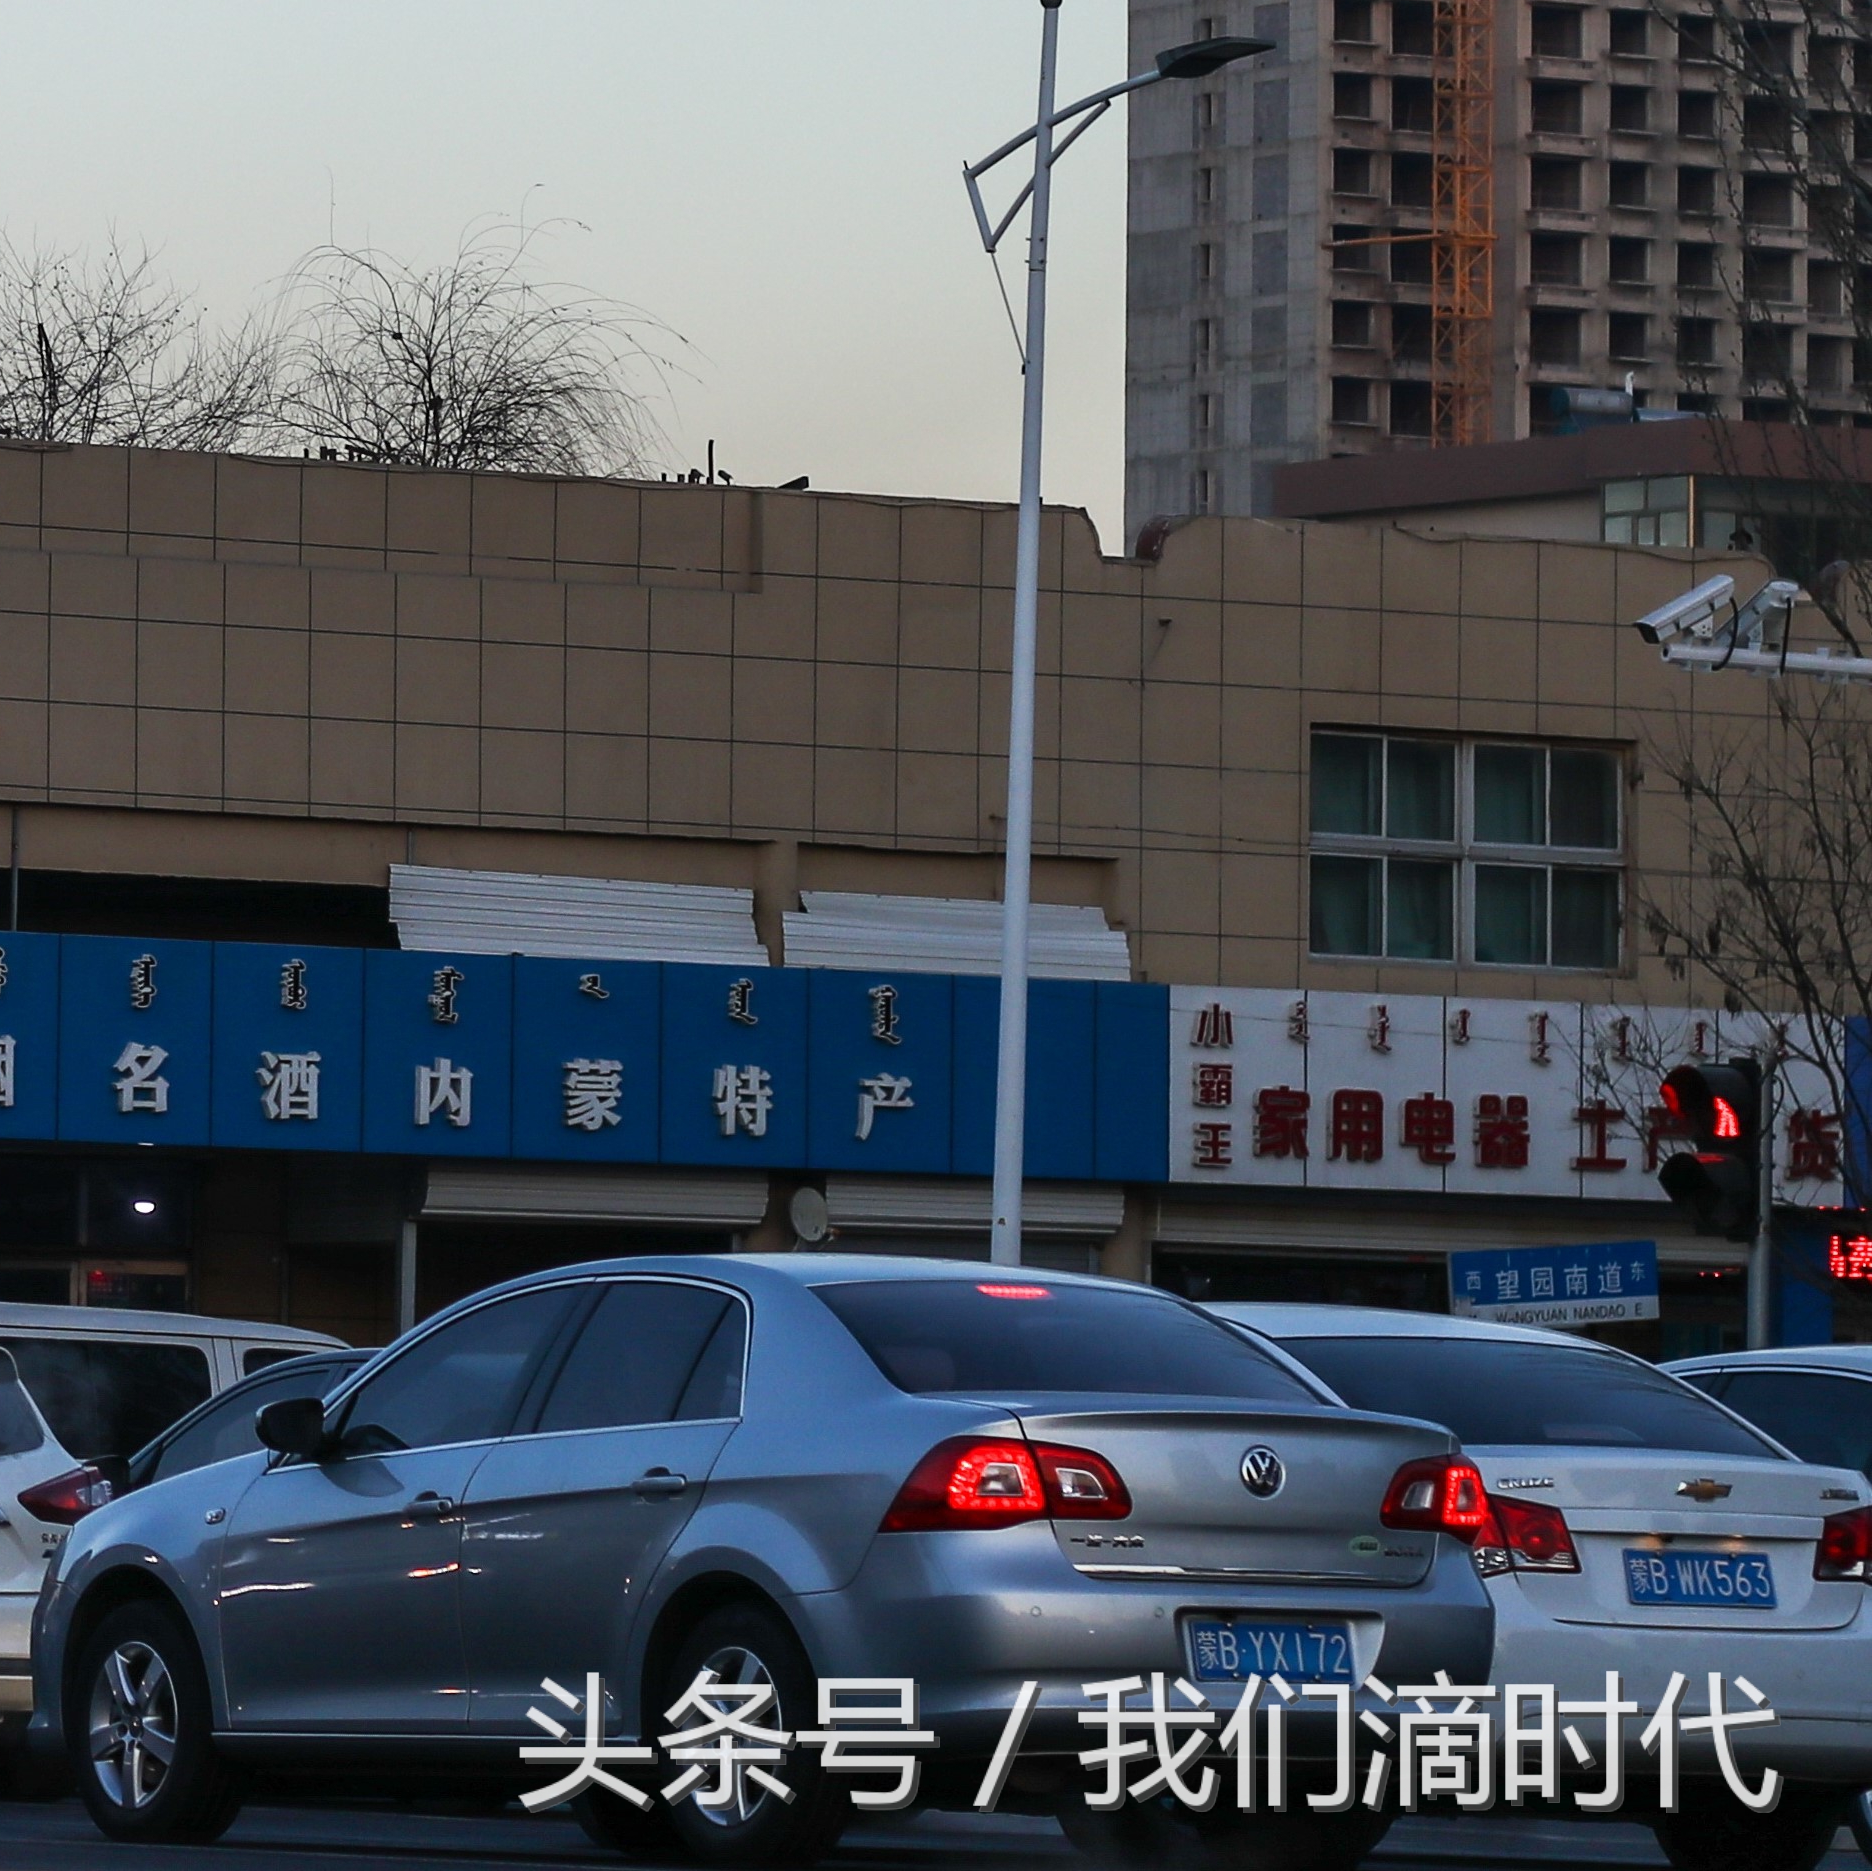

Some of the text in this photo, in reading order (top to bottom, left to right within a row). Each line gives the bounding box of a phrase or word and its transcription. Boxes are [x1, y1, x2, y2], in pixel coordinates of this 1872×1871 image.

[1191, 1003, 1235, 1169] 小霸王
[1254, 1085, 1530, 1169] 家用电器
[1465, 1260, 1646, 1300] 西 望园南道 东
[1573, 1303, 1626, 1319] NANDAO
[1634, 1302, 1644, 1315] E
[1628, 1557, 1772, 1598] 蒙B·WK563
